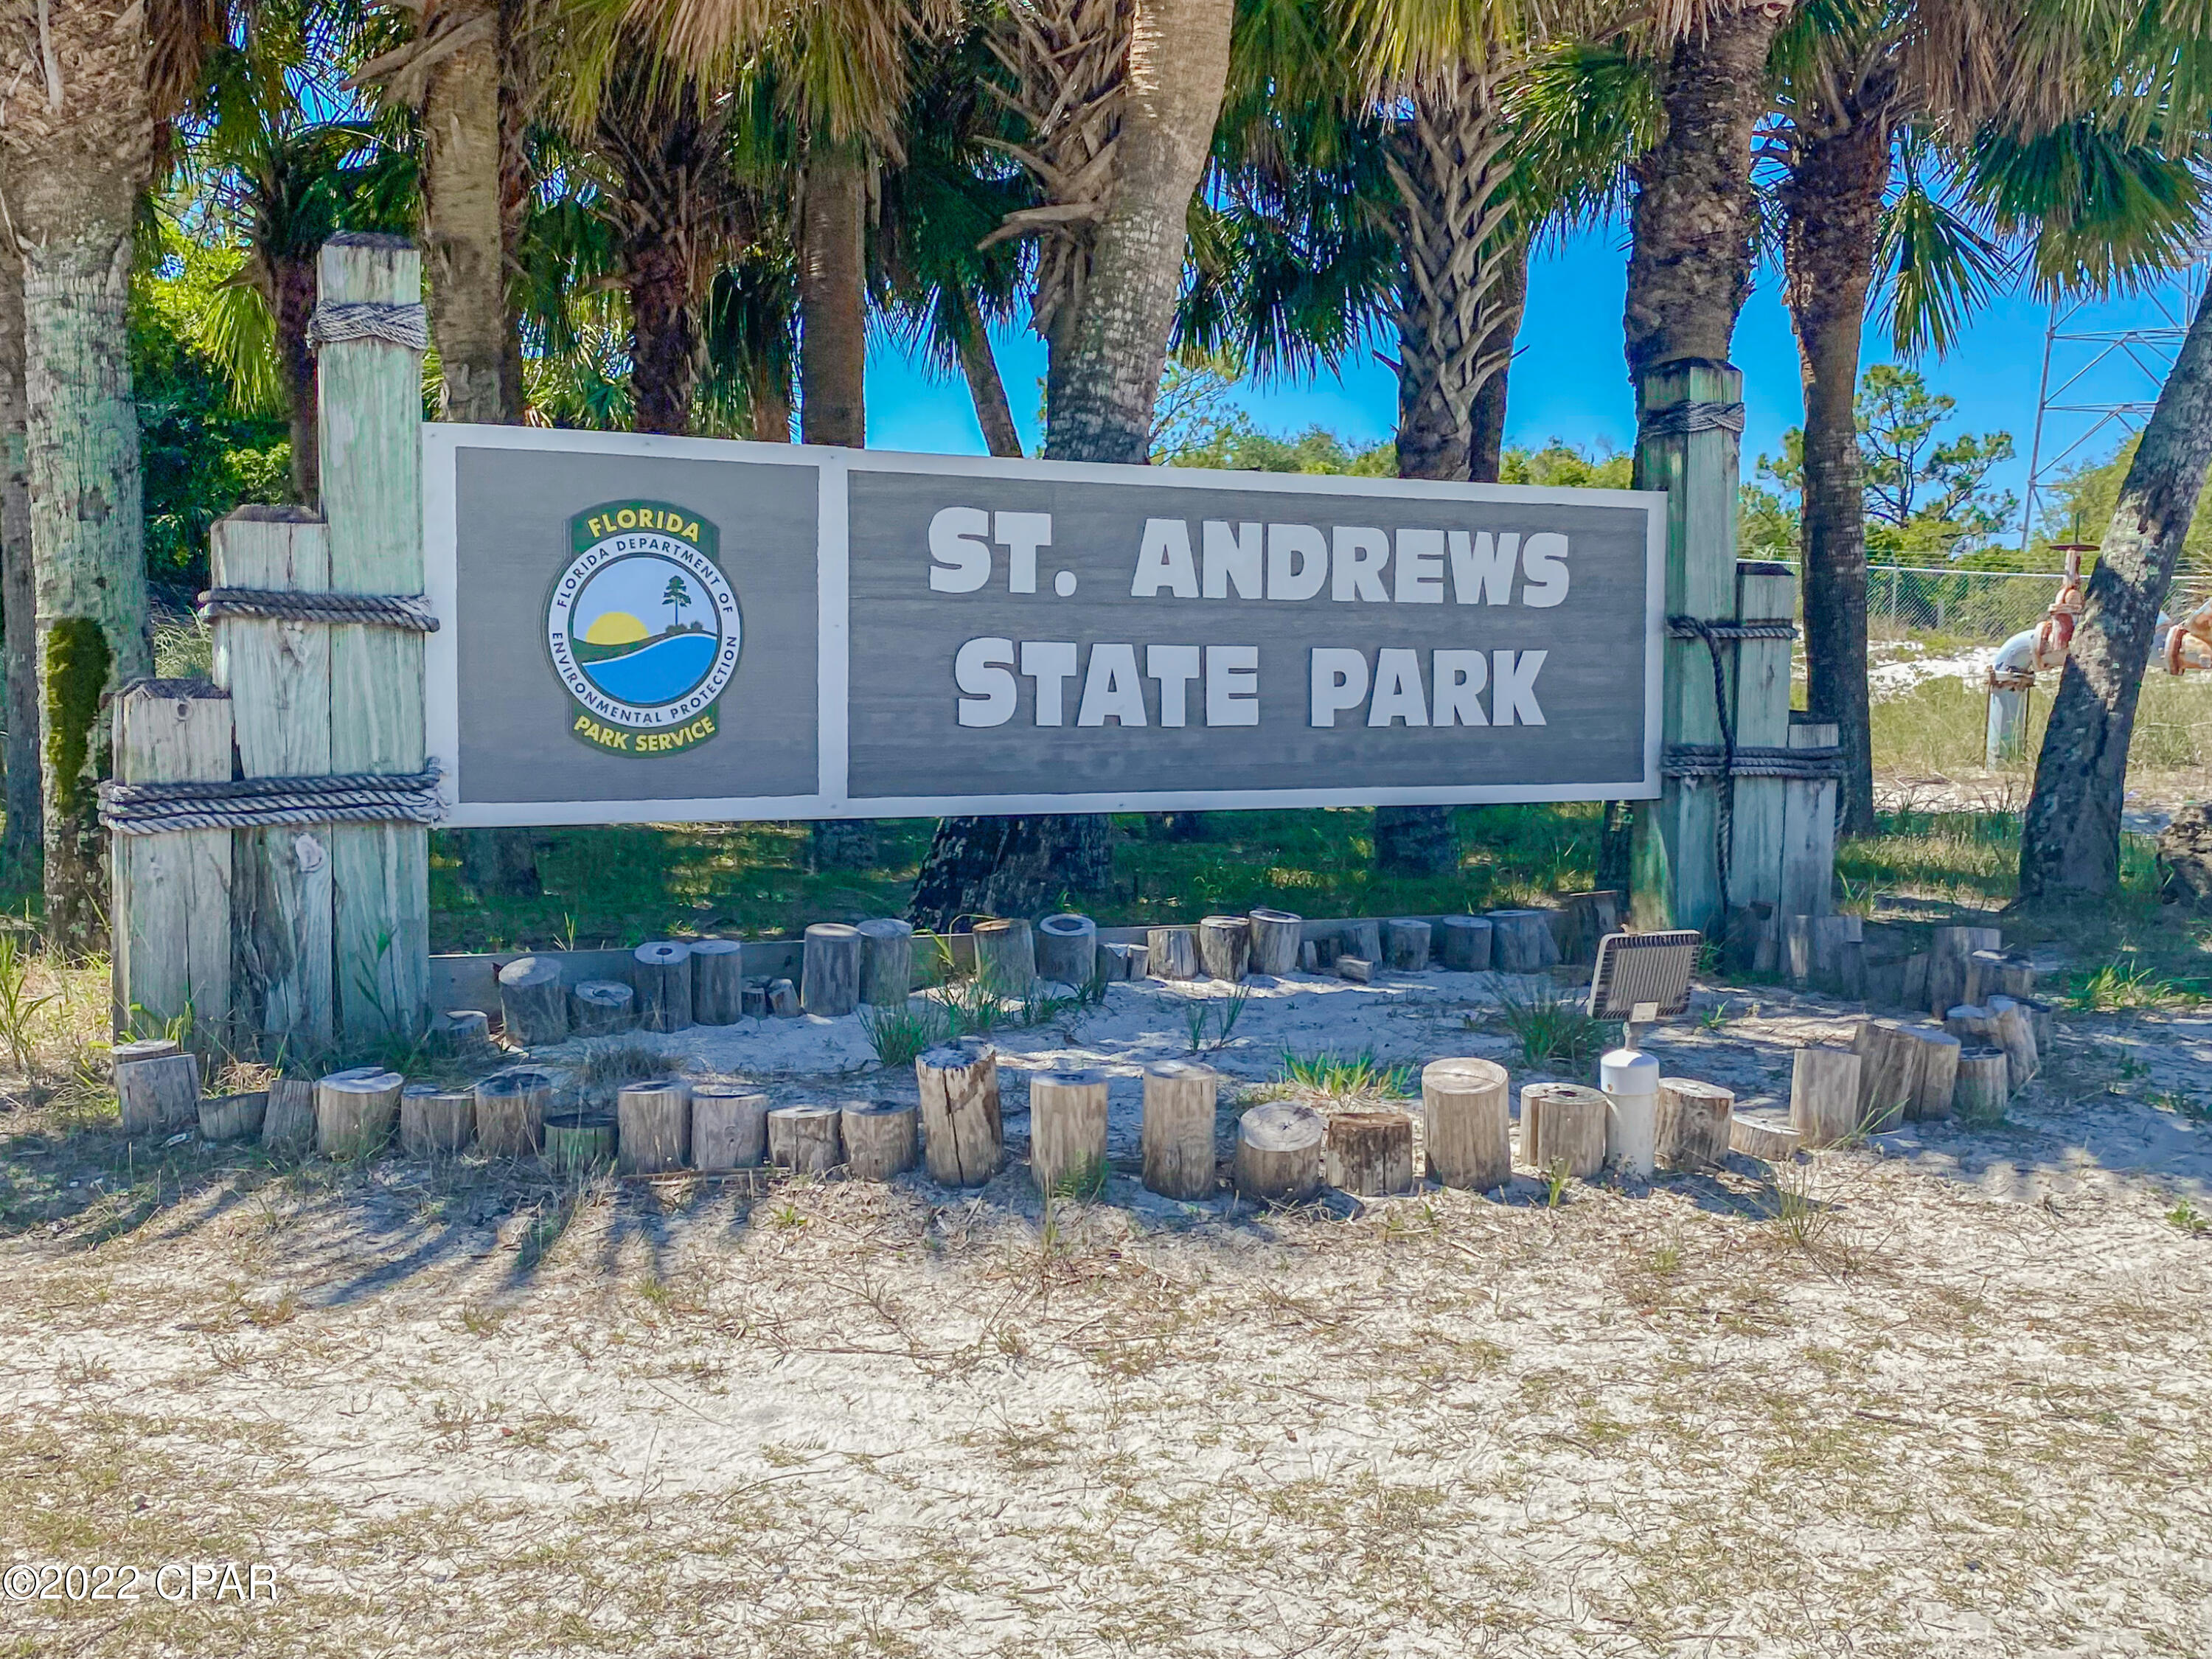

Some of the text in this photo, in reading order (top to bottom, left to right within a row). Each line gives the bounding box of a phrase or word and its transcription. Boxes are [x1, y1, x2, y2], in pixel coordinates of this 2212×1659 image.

[588, 509, 700, 542] FLORIDA
[928, 506, 1569, 608] ST. ANDREWS
[557, 538, 732, 613] FLORIDA DEPARTMENT OF
[553, 633, 737, 723] ENVIRONMENTAL PROTECTION
[954, 637, 1548, 728] STATE PARK
[574, 715, 715, 751] PARK SERVICE
